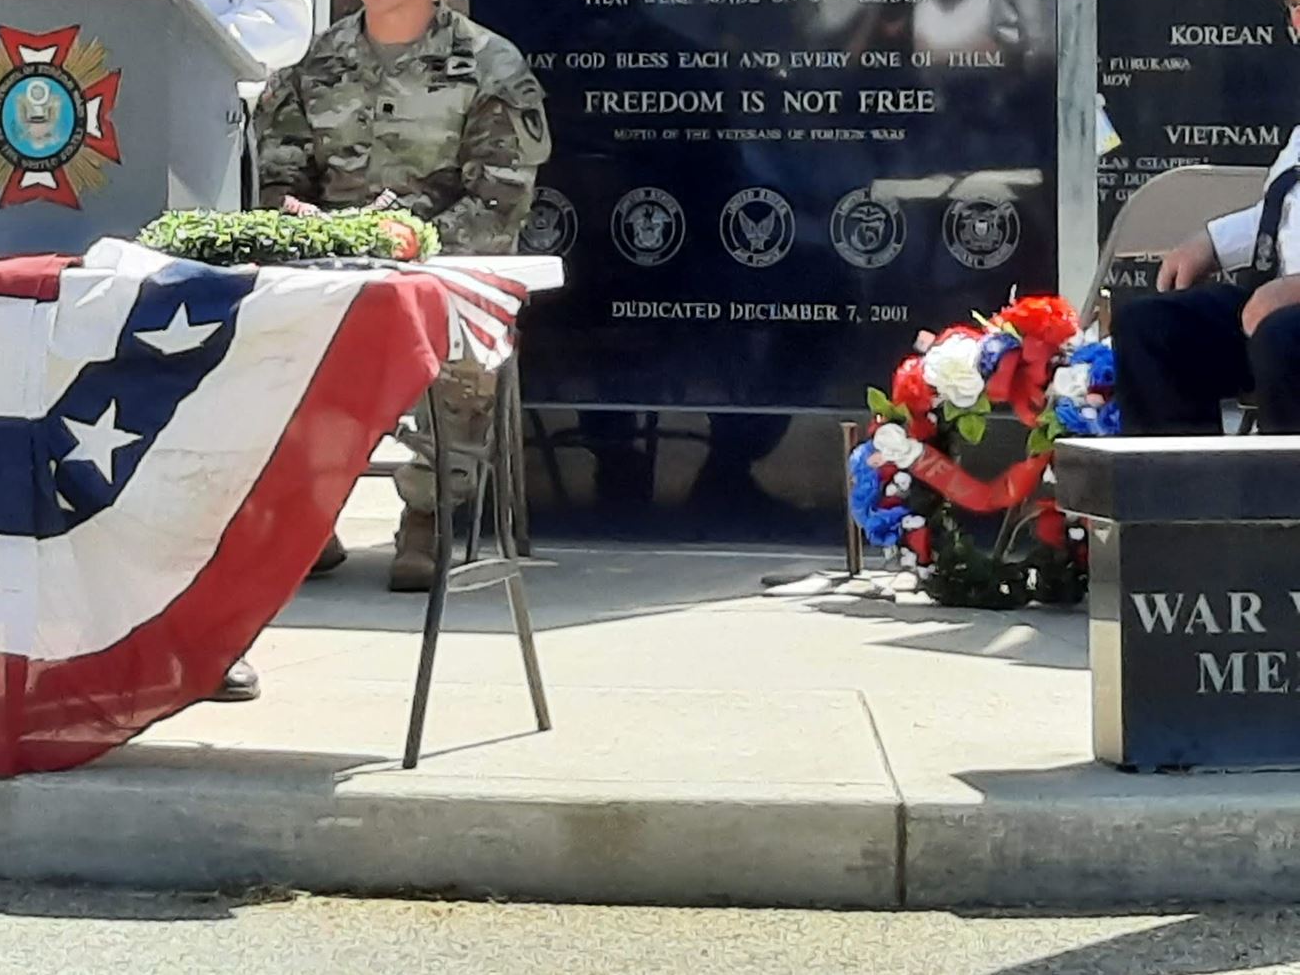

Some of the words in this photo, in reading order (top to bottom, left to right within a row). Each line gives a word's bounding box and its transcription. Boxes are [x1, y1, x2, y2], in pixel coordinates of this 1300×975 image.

[1170, 26, 1273, 45] KOREAN
[566, 53, 605, 68] GOD
[616, 52, 668, 68] BLESS
[679, 52, 728, 68] EACH
[740, 52, 780, 68] AND
[790, 52, 850, 68] EVERY
[861, 52, 900, 68] ONE
[585, 91, 723, 113] FREEDOM
[742, 91, 765, 113] IS
[784, 91, 841, 113] NOT
[859, 91, 935, 113] FREE
[1165, 126, 1280, 145] VIETNAM
[612, 302, 721, 320] DEDICATED
[730, 302, 838, 321] DECEMBER
[847, 303, 861, 324] 7,
[871, 304, 908, 321] 2001
[1129, 592, 1267, 634] WAR
